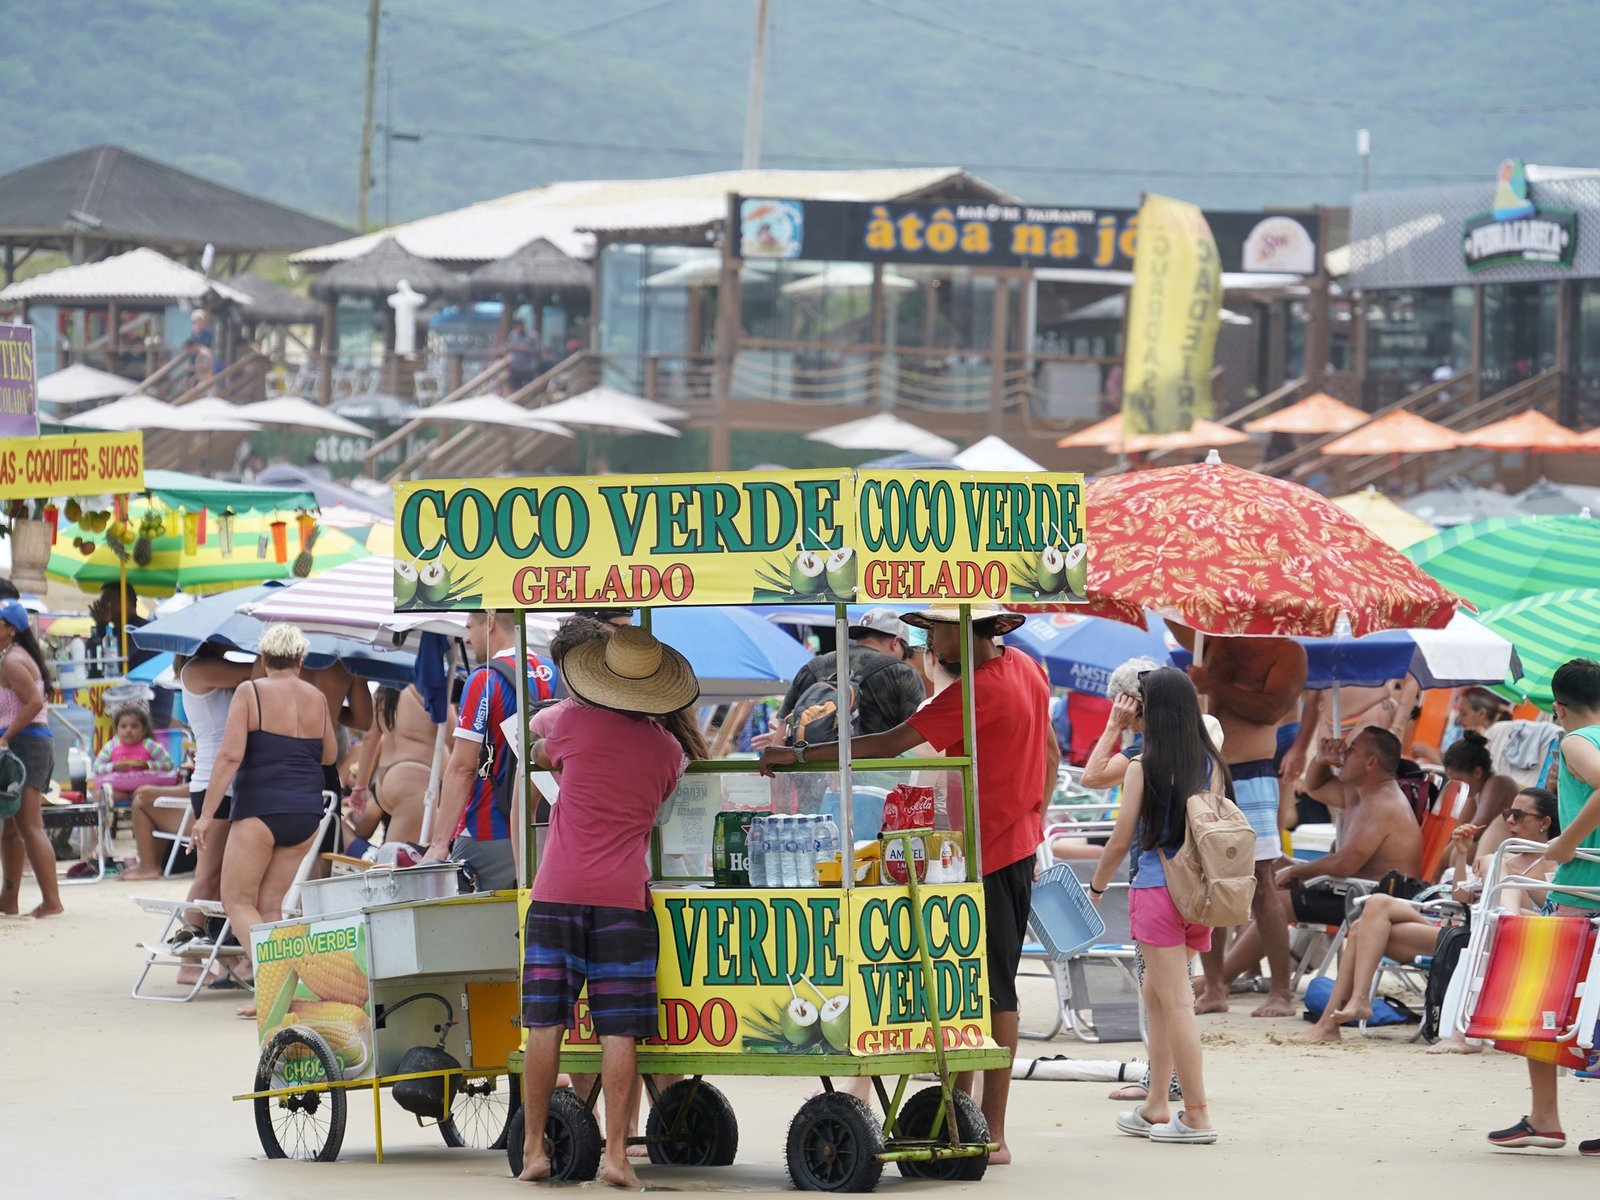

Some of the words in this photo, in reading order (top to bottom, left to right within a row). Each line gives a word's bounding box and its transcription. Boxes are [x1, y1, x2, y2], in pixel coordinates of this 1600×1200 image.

[1011, 223, 1079, 258] na
[26, 440, 88, 486] COQUITÉIS
[99, 445, 139, 480] SUCOS
[400, 486, 590, 560] COCO
[598, 479, 844, 556] VERDE
[859, 479, 956, 553] COCO
[960, 482, 1083, 552] VERDE
[512, 562, 694, 606] GELADO
[864, 560, 1008, 599] GELADO
[1069, 663, 1113, 683] AMST
[256, 935, 305, 963] MILHO
[305, 926, 357, 954] VERDE
[665, 898, 844, 987] VERDE
[859, 893, 981, 962] COCO
[858, 957, 984, 1026] VERDE
[856, 1023, 985, 1054] GELADO
